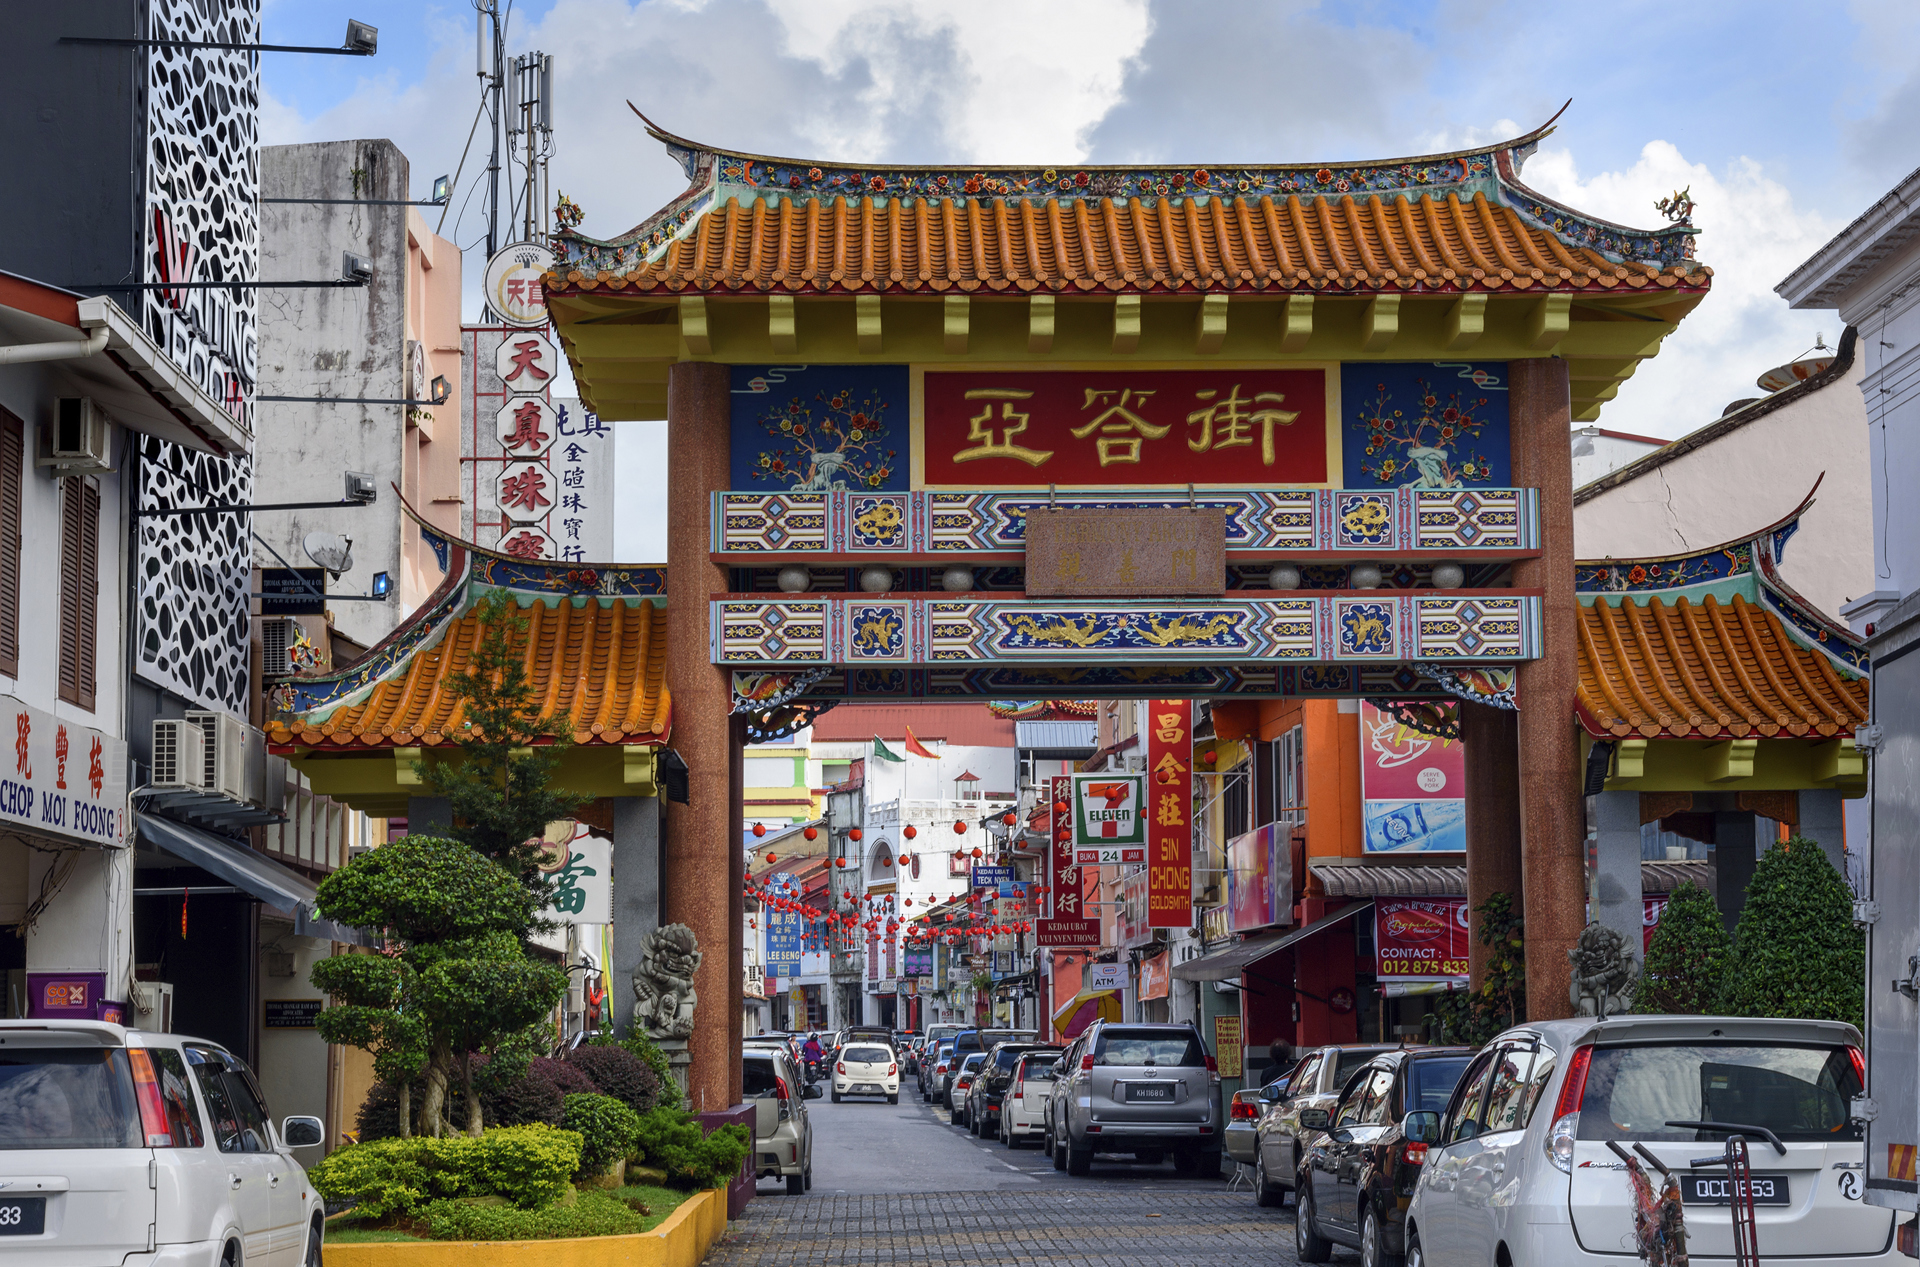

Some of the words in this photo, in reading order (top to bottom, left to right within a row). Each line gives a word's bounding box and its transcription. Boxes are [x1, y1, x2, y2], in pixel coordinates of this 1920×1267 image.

[154, 209, 257, 384] WAITING
[165, 312, 244, 428] ROOM
[952, 382, 1302, 468] 亞答街
[1054, 520, 1145, 543] HARMONY
[1149, 519, 1197, 542] ARCH
[1054, 548, 1198, 583] 親善門
[1154, 699, 1187, 827] 昌金莊
[0, 779, 34, 819] CHOP
[41, 791, 66, 828] MOI
[74, 800, 114, 839] FOONG
[1383, 815, 1413, 843] REVIVE
[1080, 852, 1096, 861] BUKA
[1102, 850, 1118, 861] 24
[1127, 851, 1140, 860] JAM
[1161, 838, 1179, 861] SIN
[977, 876, 993, 885] TECK
[1151, 867, 1190, 890] CHONG
[1150, 895, 1190, 911] GOLDSMITH
[1435, 906, 1447, 916] at
[1048, 922, 1070, 931] KEDAI
[1070, 922, 1088, 931] UBAT
[1393, 919, 1446, 930] Popular
[1039, 934, 1053, 943] VUI
[1053, 935, 1072, 943] NYEN
[1072, 934, 1097, 943] THONG
[767, 951, 780, 960] LEE
[781, 951, 800, 960] SENG
[1380, 948, 1436, 959] CONTACT
[1382, 960, 1409, 974] 012
[1412, 960, 1439, 974] 875
[1442, 960, 1469, 974] 833
[1094, 978, 1114, 986] ATM
[47, 986, 67, 997] GO
[790, 990, 804, 1002] 42
